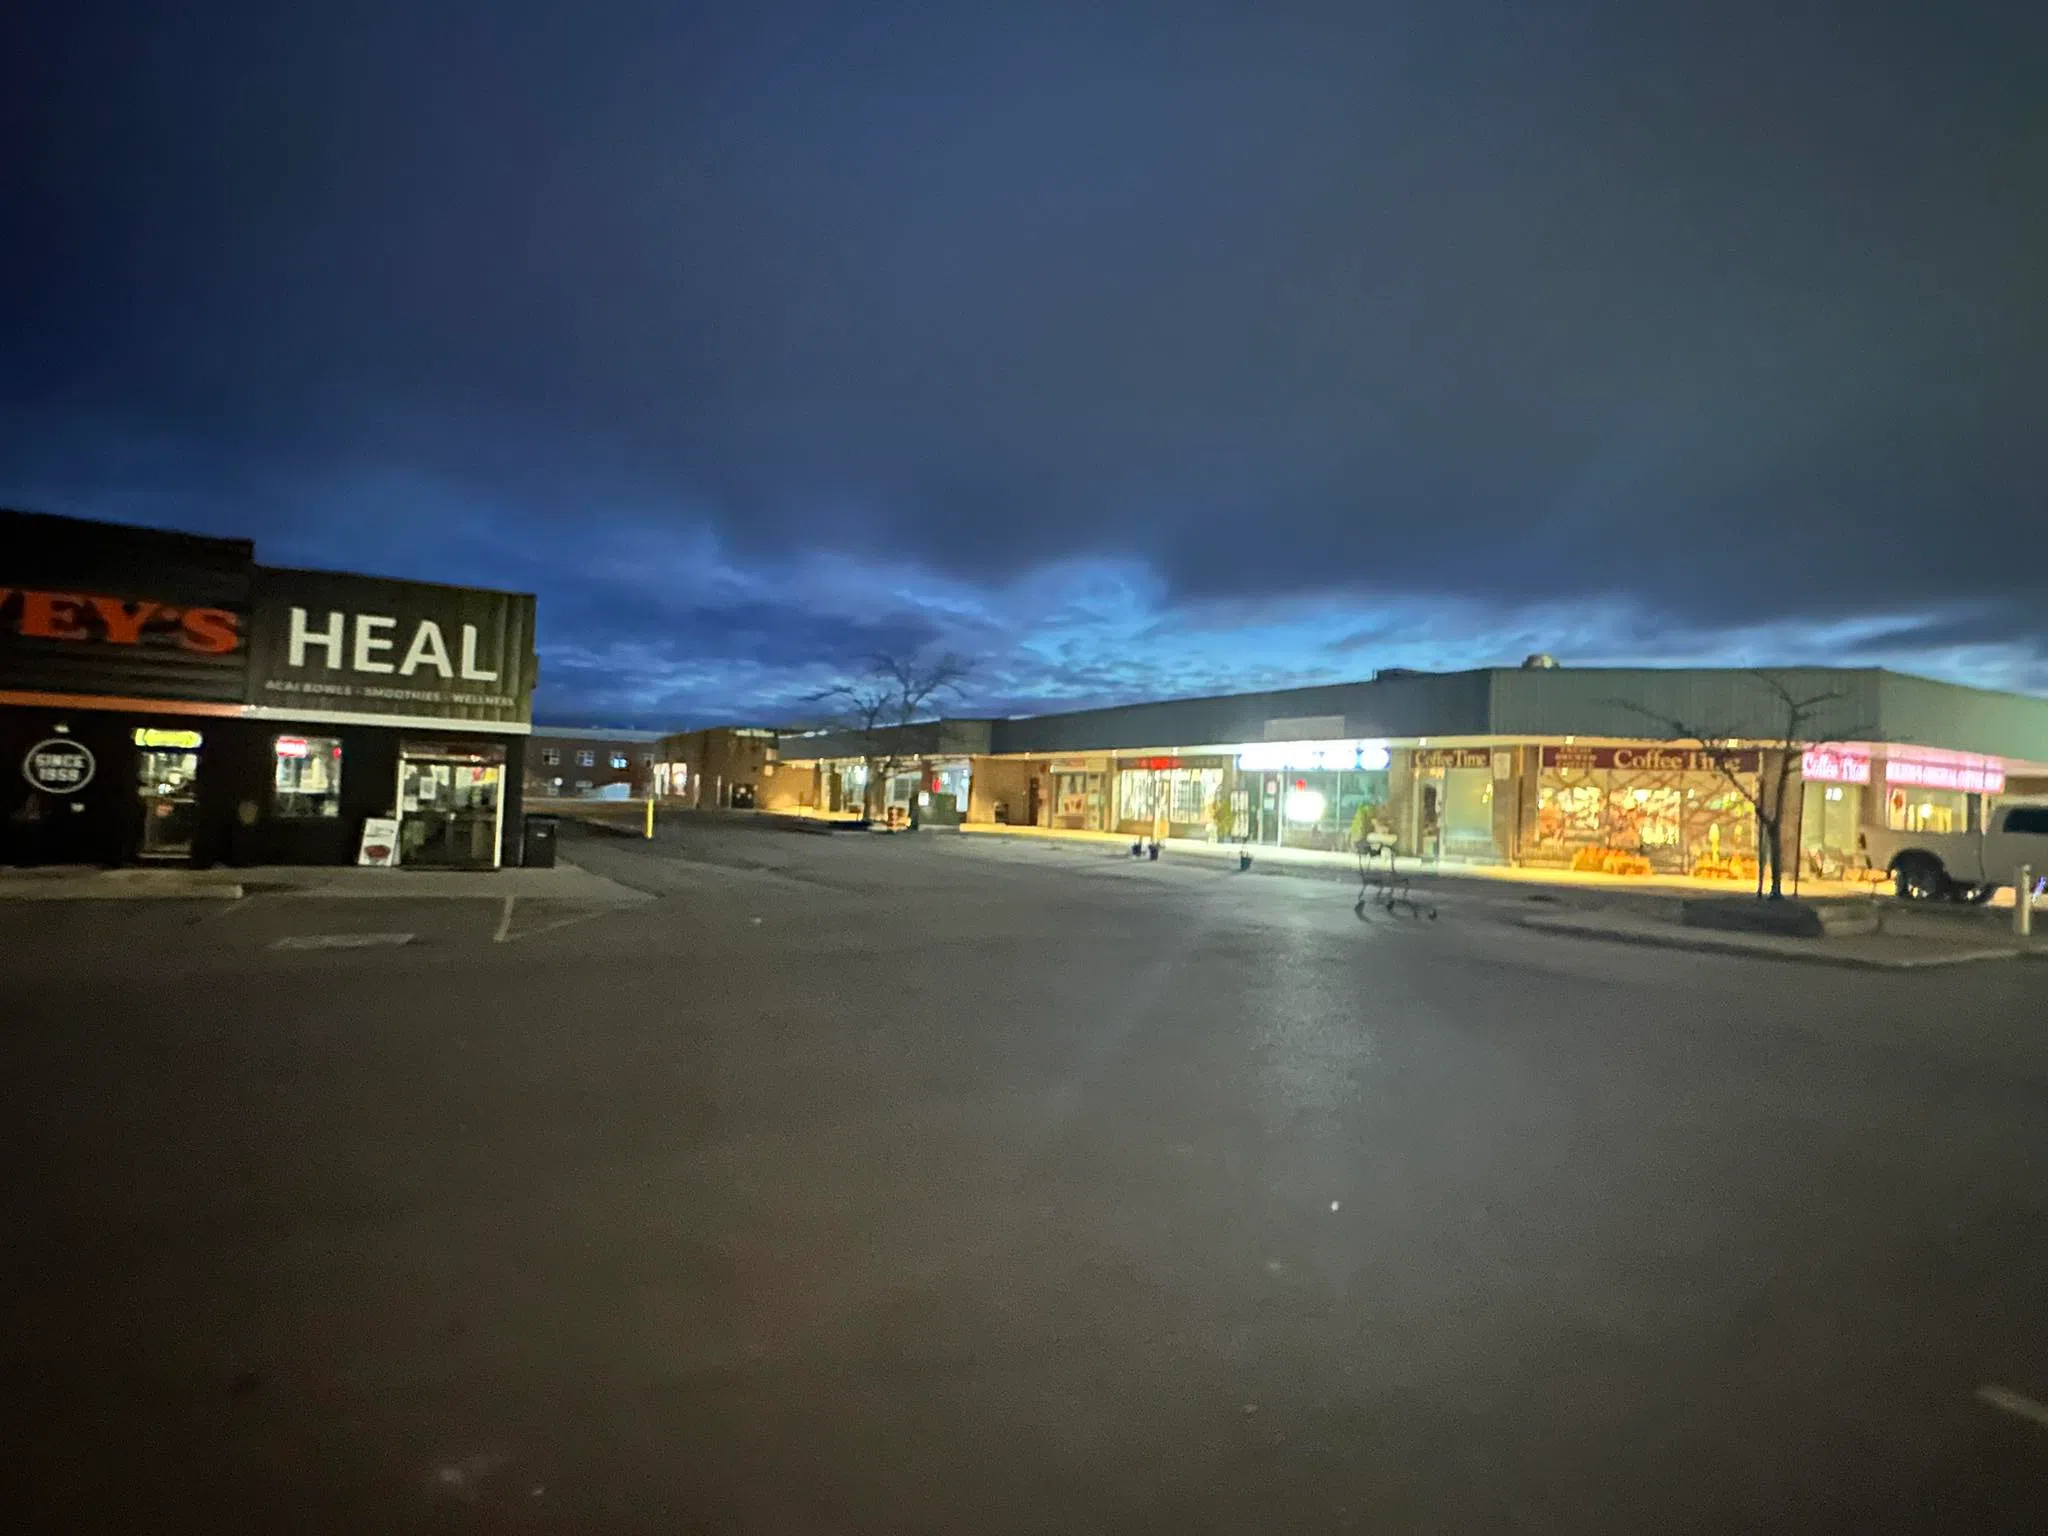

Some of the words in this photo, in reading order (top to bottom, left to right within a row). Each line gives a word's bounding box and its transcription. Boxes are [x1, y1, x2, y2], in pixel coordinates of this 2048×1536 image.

[0, 588, 238, 654] EY'S
[289, 607, 498, 682] HEAL
[363, 686, 441, 702] SMOOTHIES
[452, 694, 515, 707] WELLNESS
[1613, 749, 1682, 769] Coffee
